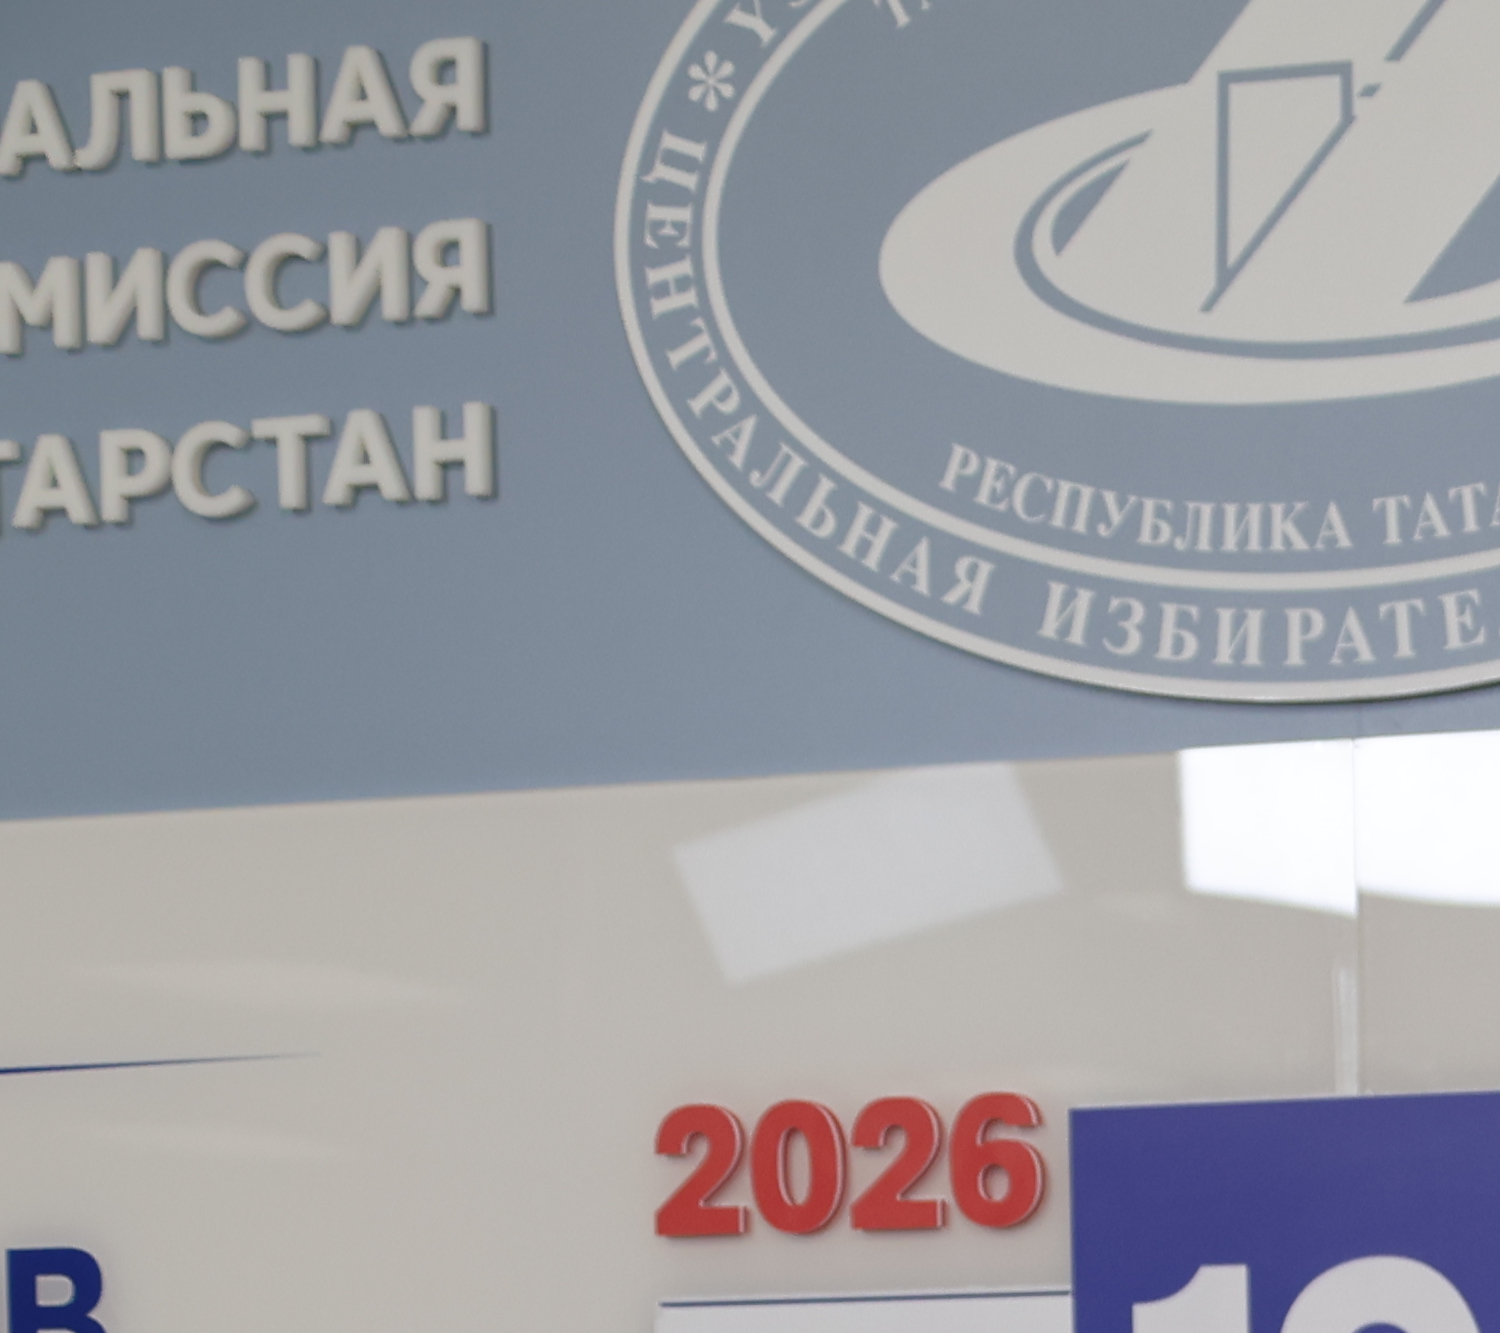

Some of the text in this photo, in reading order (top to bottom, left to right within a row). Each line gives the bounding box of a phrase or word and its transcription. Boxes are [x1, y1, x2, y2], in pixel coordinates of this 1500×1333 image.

[0, 36, 487, 176] АЛЬНАЯ
[0, 217, 489, 355] МИССИЯ
[641, 130, 997, 617] ЦЕНТРАЛЬНАЯ
[0, 401, 493, 528] АРСТАН
[938, 442, 1354, 554] РЕСПУБЛИКА
[653, 1091, 1046, 1239] 2026
